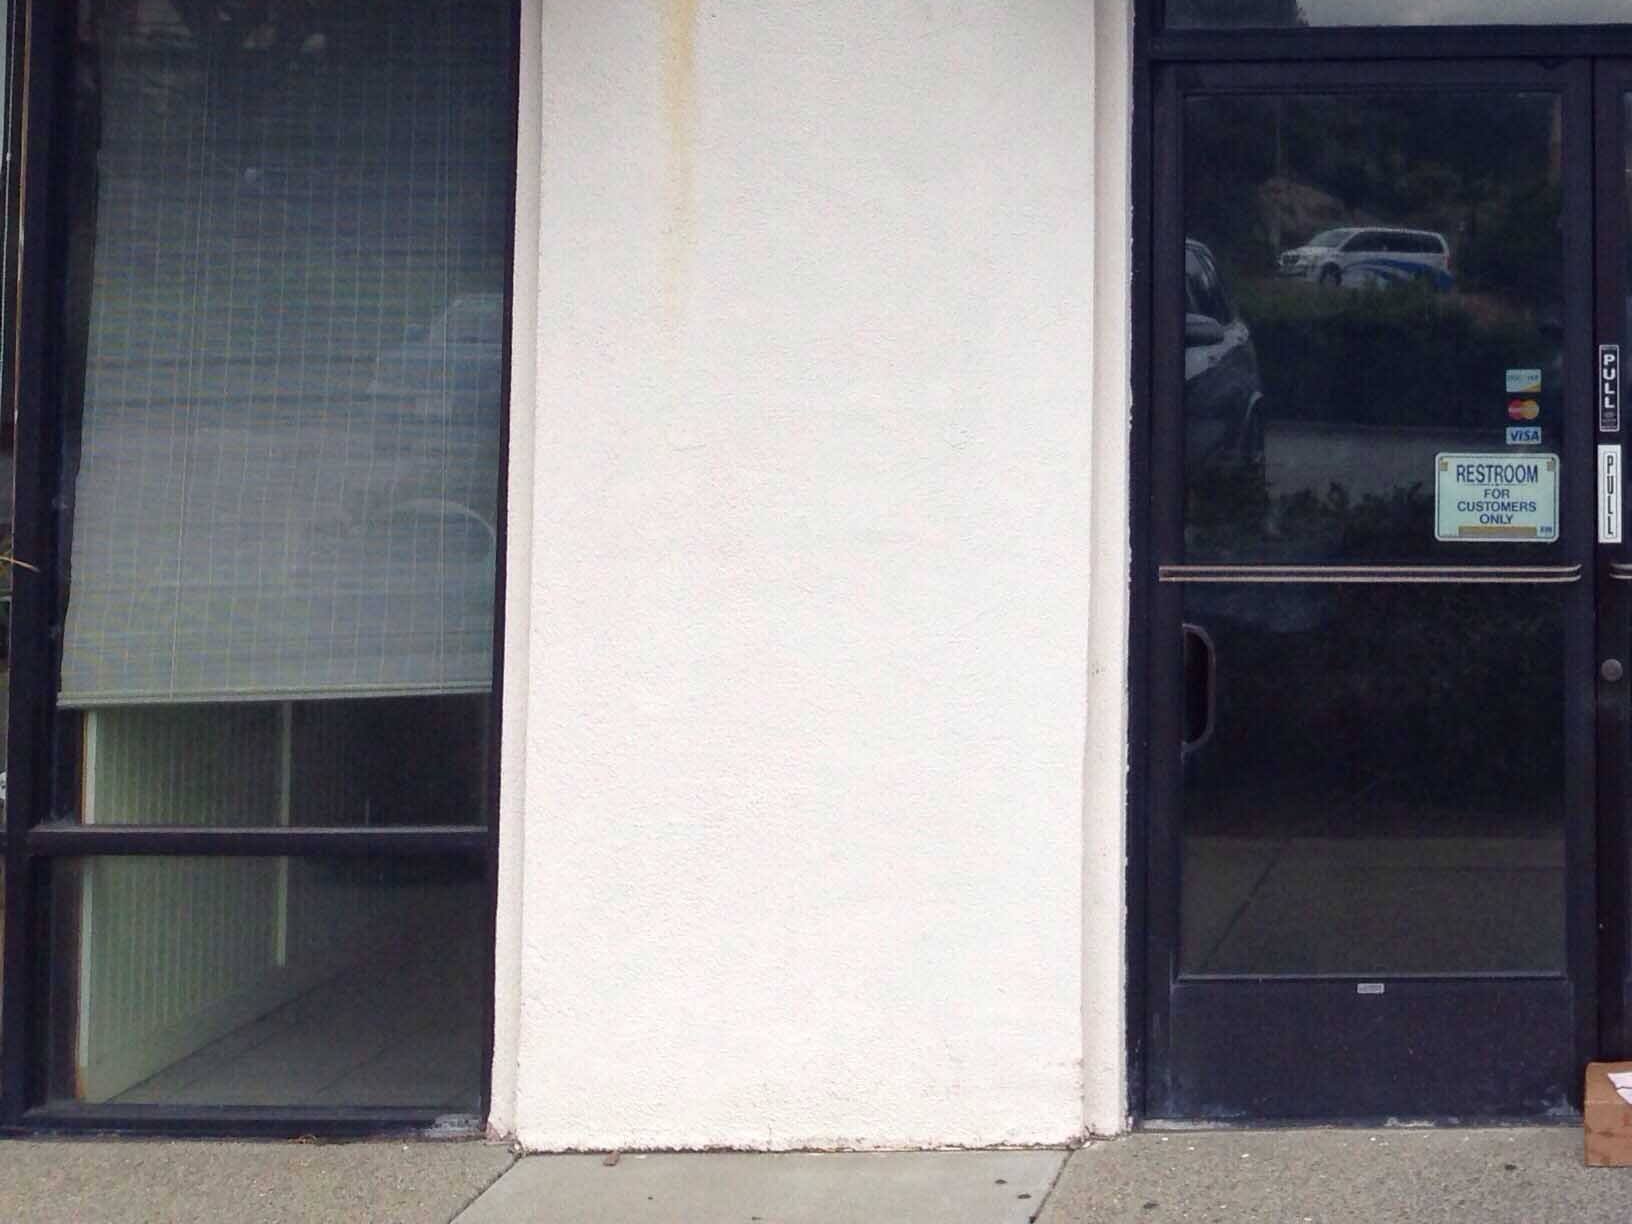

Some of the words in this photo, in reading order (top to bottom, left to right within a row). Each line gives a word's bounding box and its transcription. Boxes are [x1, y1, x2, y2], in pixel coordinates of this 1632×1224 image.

[1603, 353, 1616, 409] PULL
[1511, 430, 1540, 442] VISA
[1456, 463, 1539, 484] RESTROOM
[1484, 488, 1510, 499] FOR
[1606, 455, 1615, 536] PULL
[1457, 501, 1536, 512] CUSTOMERS
[1479, 513, 1514, 525] ONLY
